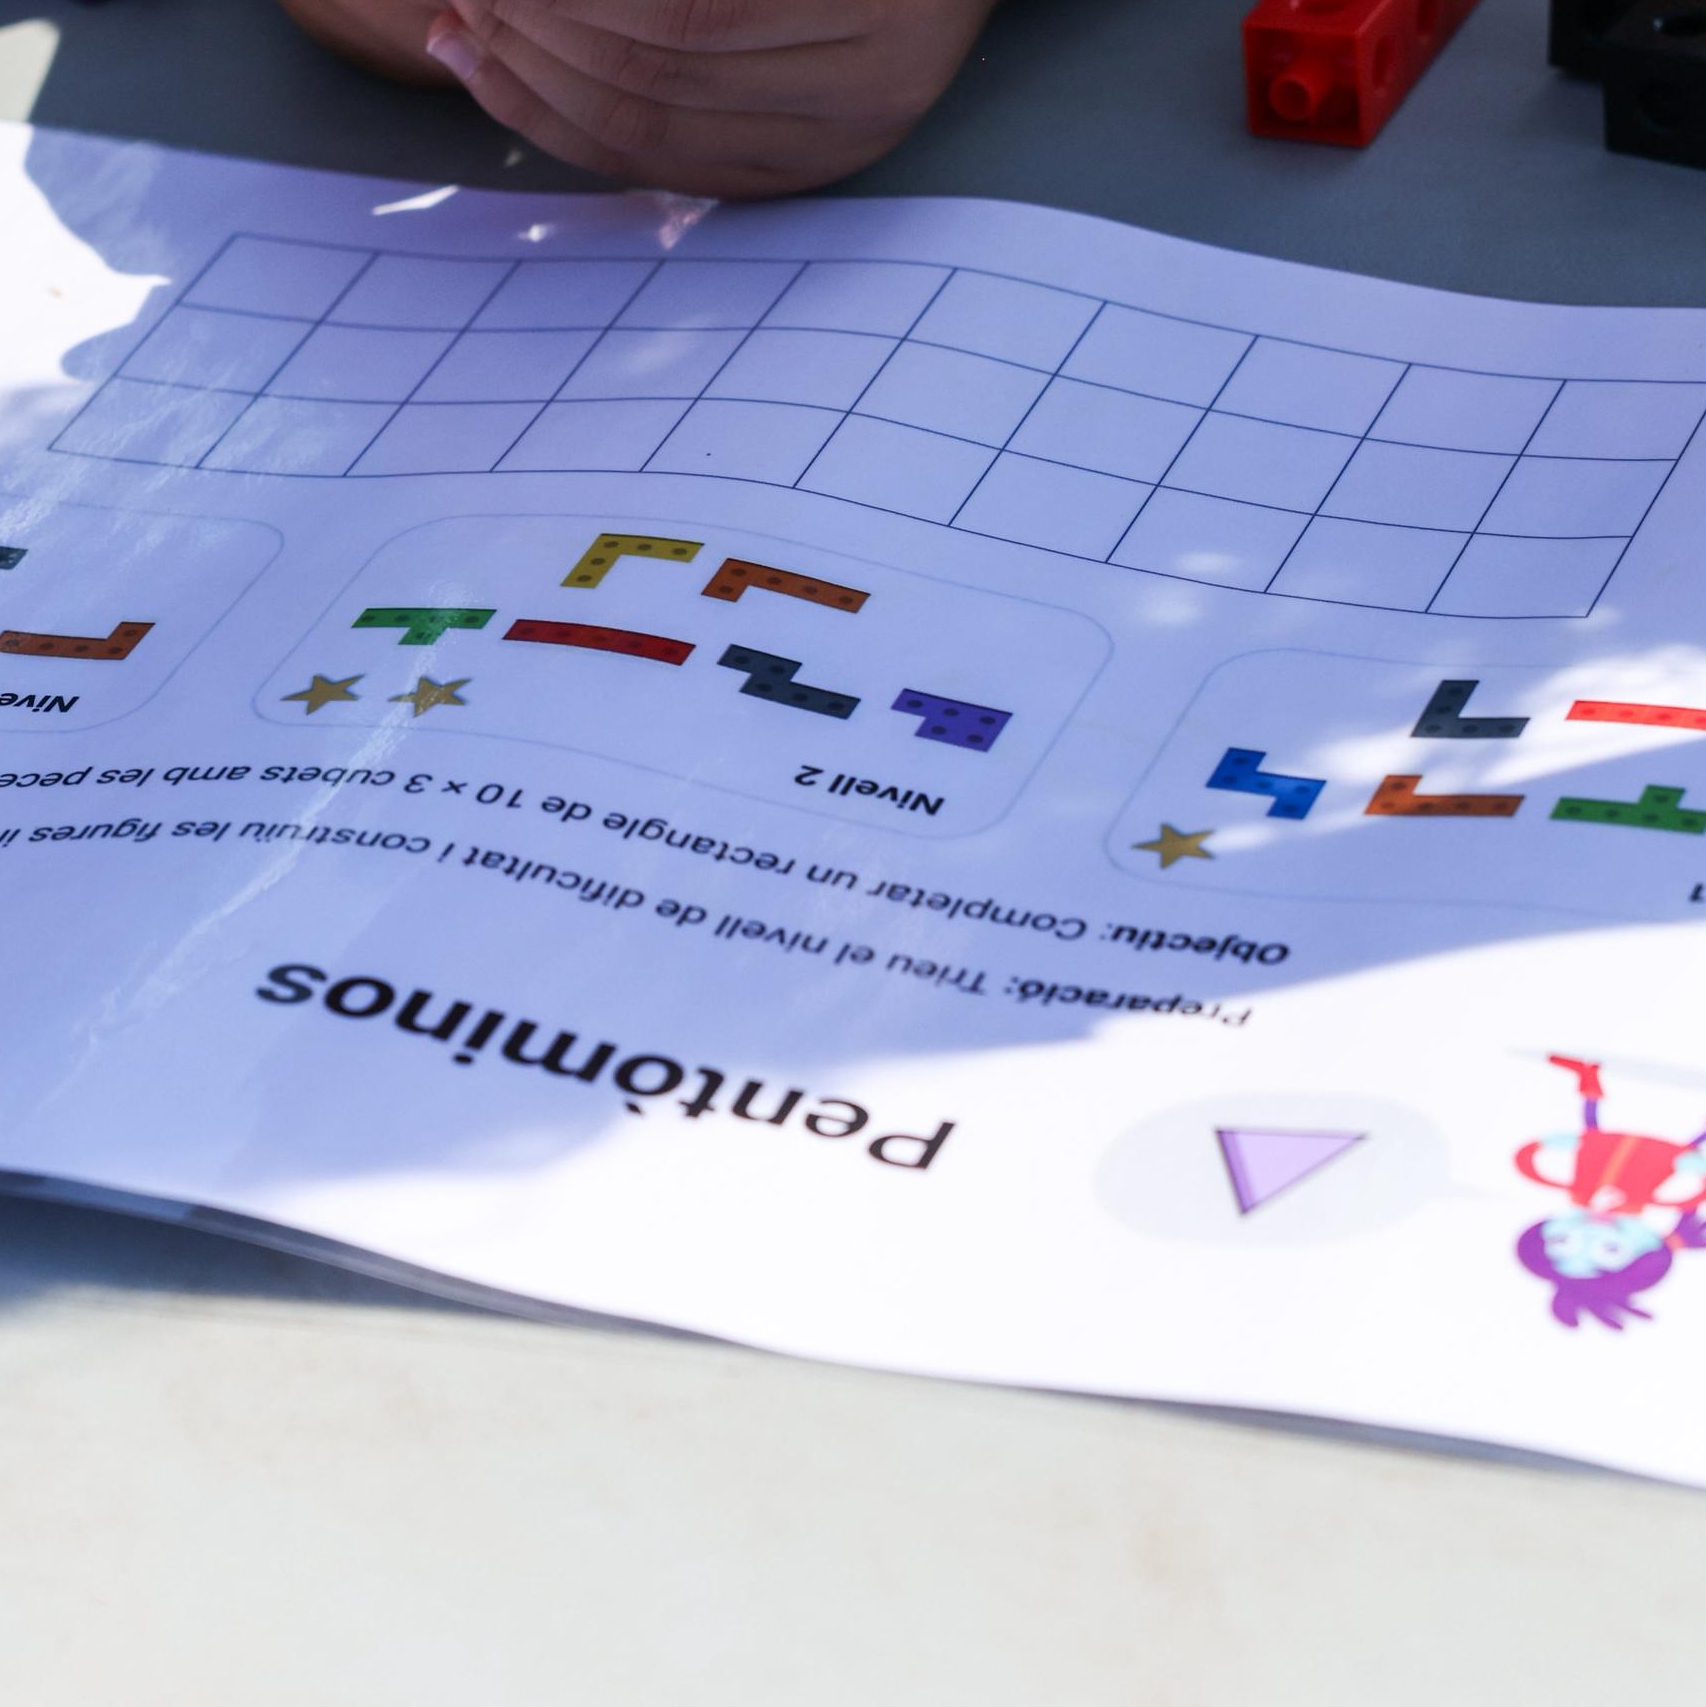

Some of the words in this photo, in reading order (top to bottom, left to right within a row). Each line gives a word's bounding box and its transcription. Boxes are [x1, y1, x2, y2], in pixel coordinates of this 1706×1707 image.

[96, 768, 155, 787] les
[162, 766, 252, 786] amb
[259, 766, 396, 787] cubets
[403, 773, 433, 794] 3
[794, 765, 825, 787] 2
[475, 783, 523, 809] 10
[827, 773, 945, 816] Nivell
[540, 796, 593, 823] de
[28, 818, 163, 843] figures
[171, 821, 232, 842] les
[602, 812, 796, 875] rectangle
[462, 846, 645, 910] dificultat
[806, 864, 858, 890] un
[1688, 883, 1705, 903] 1
[655, 899, 708, 927] de
[866, 881, 1088, 941] Completar
[713, 914, 829, 957] nivell
[1100, 923, 1291, 966] Objectiu:
[834, 942, 876, 965] el
[886, 954, 986, 995] Trieu
[254, 963, 957, 1172] Pentòminos
